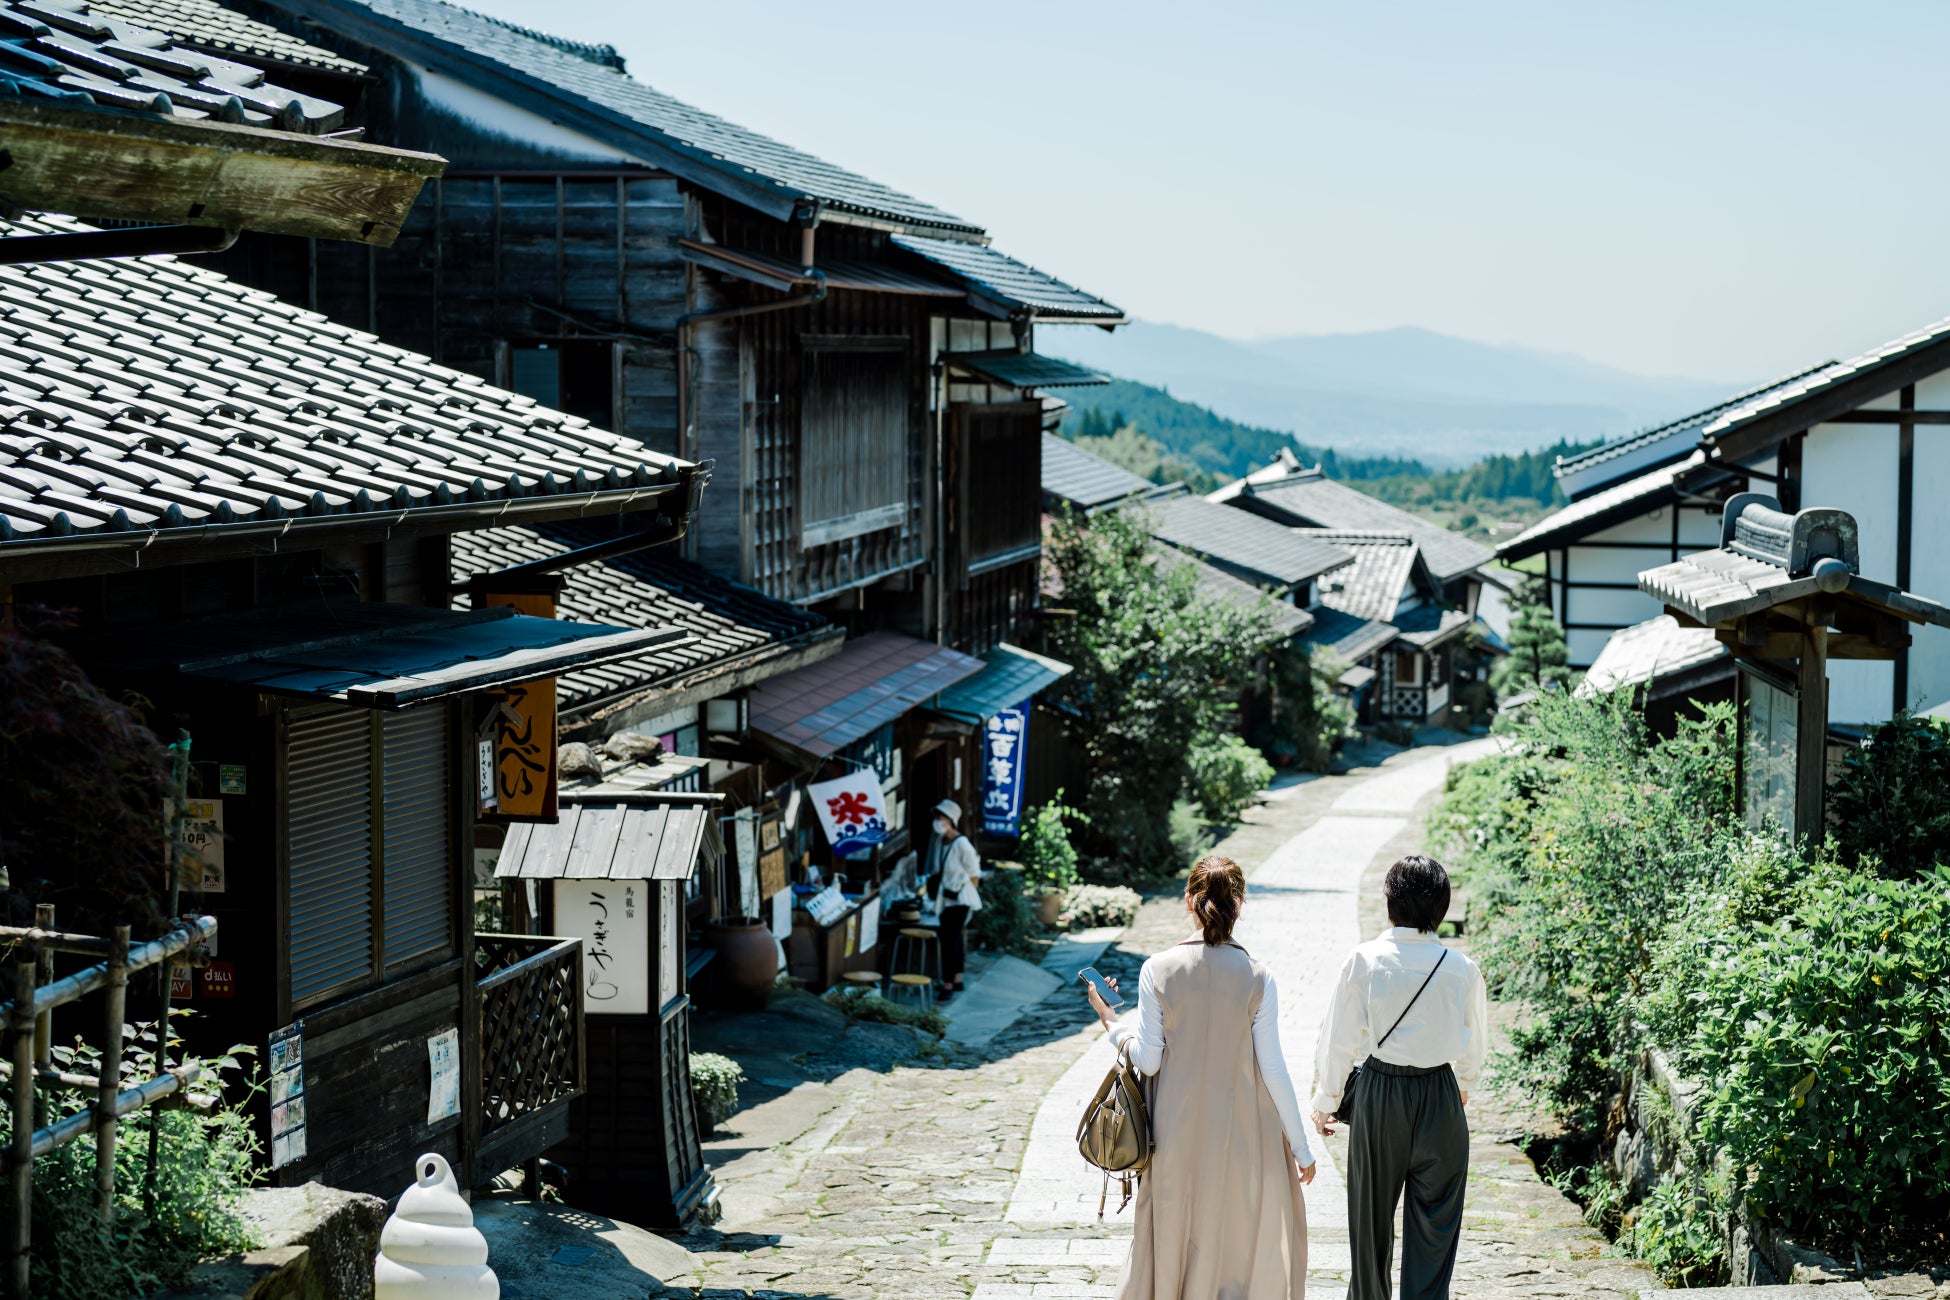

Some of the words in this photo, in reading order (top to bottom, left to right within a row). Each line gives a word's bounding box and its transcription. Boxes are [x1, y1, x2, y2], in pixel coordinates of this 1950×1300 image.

[827, 791, 877, 825] 氷
[625, 886, 635, 919] 馬籠宿
[587, 891, 614, 971] うさぎや
[172, 981, 186, 992] AY
[204, 968, 232, 982] d払い
